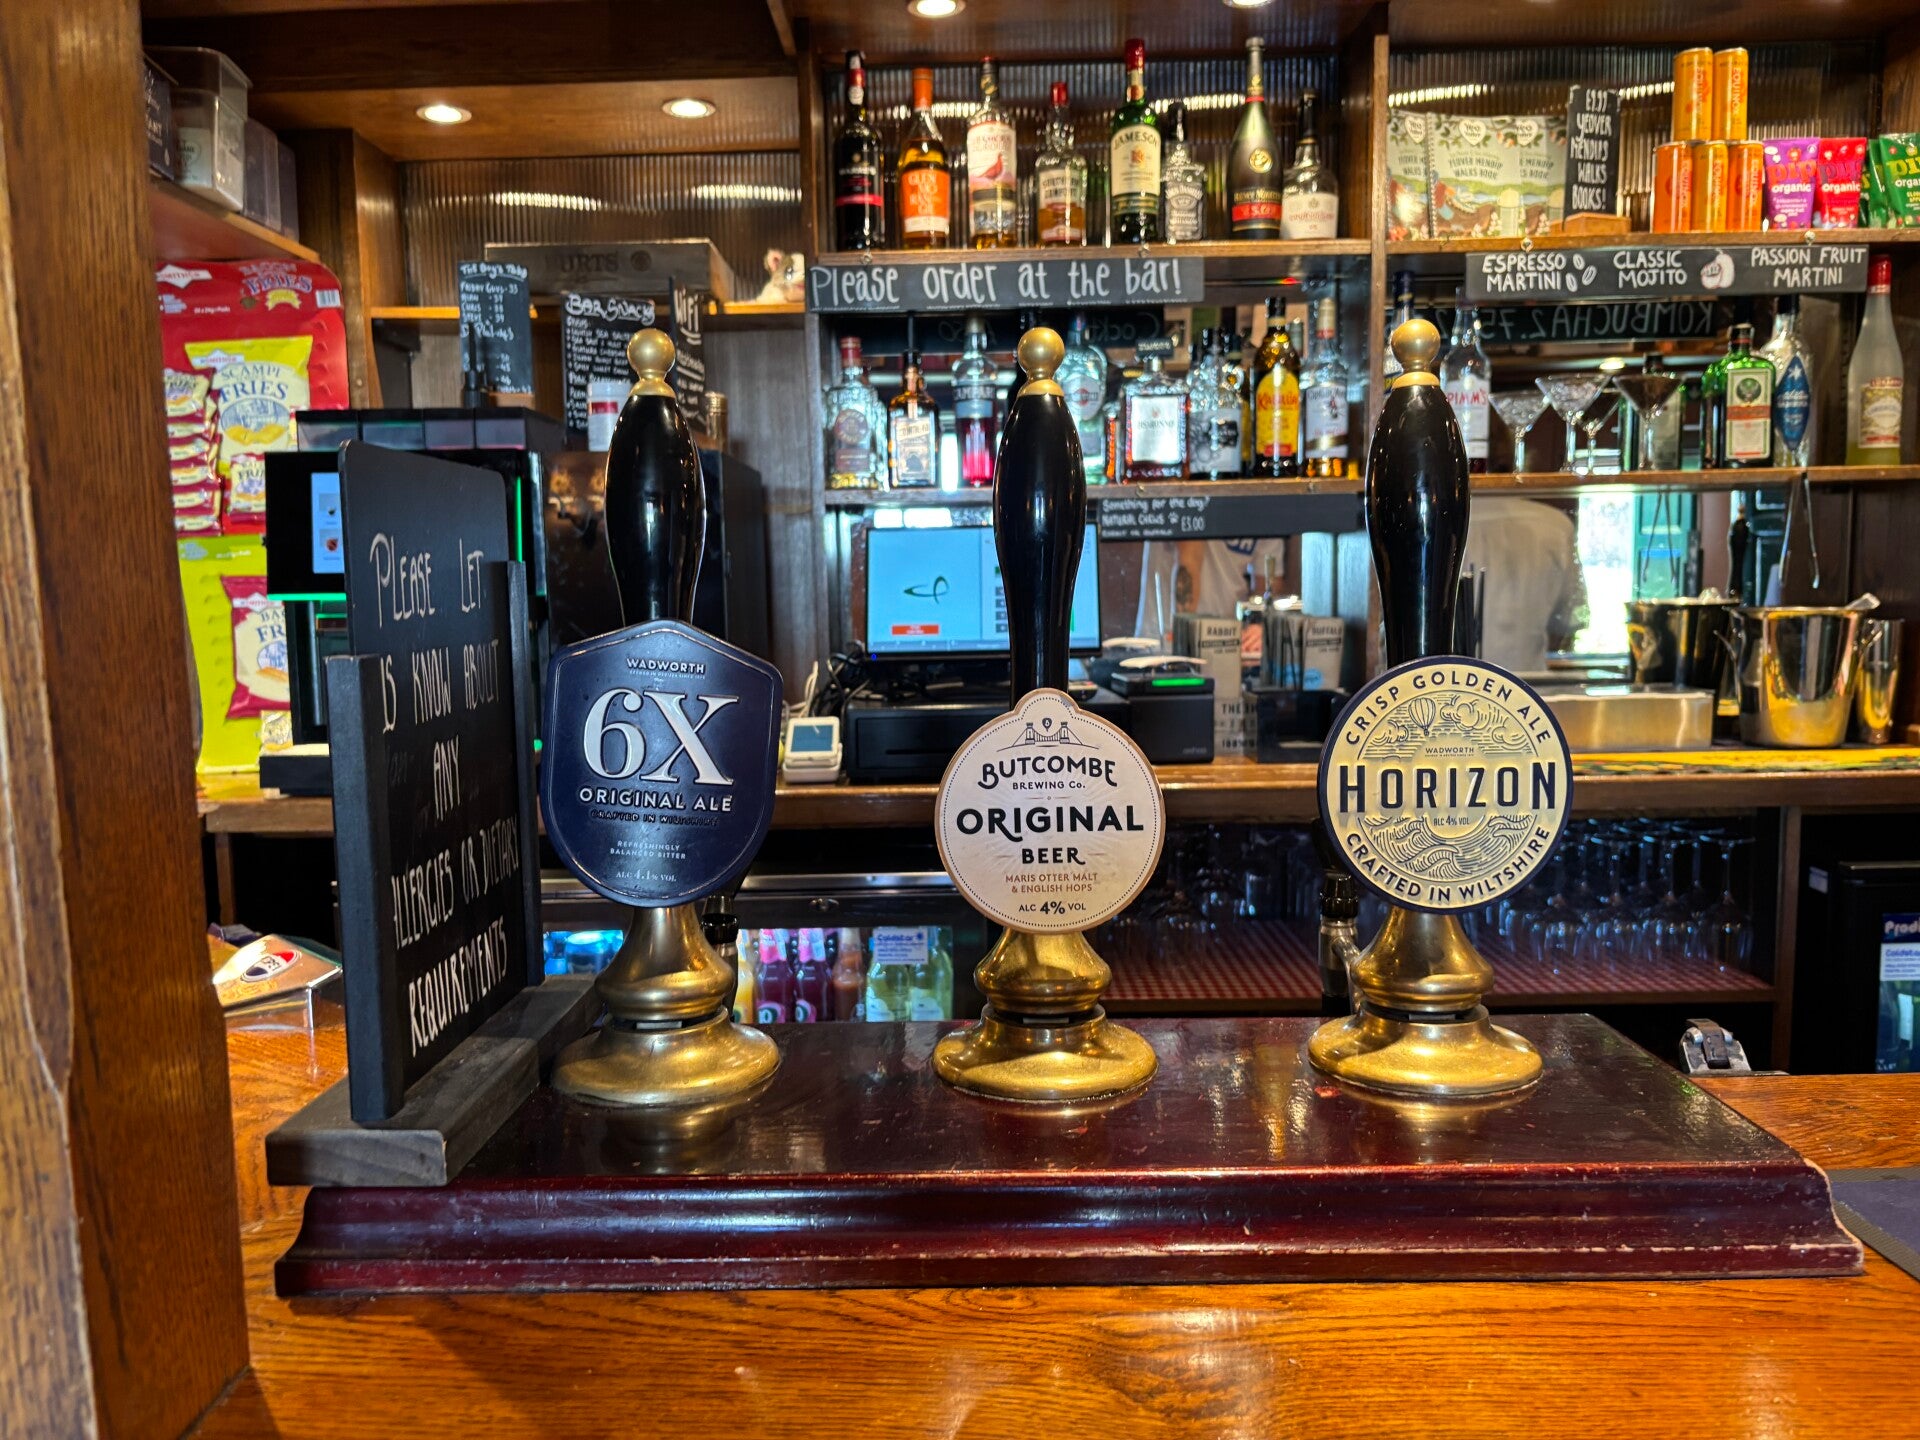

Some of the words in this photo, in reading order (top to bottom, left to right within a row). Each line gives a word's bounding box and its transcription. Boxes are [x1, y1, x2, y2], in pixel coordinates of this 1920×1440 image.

[1771, 182, 1812, 195] organic
[1482, 253, 1566, 274] ESPRESSO
[1613, 250, 1682, 269] CLASSIC
[1751, 248, 1811, 268] PASSION
[1820, 247, 1867, 266] FRUIT
[243, 274, 313, 296] FRIES
[810, 265, 899, 306] Please
[922, 262, 998, 304] order
[1018, 261, 1050, 300] at
[1067, 260, 1110, 299] the
[1125, 257, 1182, 296] bar!
[1486, 271, 1561, 293] MARTINI
[1617, 269, 1688, 289] MOJITO
[1773, 267, 1843, 288] MARTINI
[221, 365, 282, 380] SCAMPI
[219, 380, 289, 405] FRIES
[369, 532, 436, 629] PLEASE
[459, 538, 484, 614] LET
[1206, 626, 1238, 637] RABBIT
[627, 657, 706, 675] WADWORTH
[412, 647, 452, 726] KNOW
[463, 639, 499, 711] ABOUT
[1345, 686, 1399, 746] CRISP
[1413, 670, 1513, 702] GOLDEN
[1517, 704, 1551, 744] ALE
[583, 688, 740, 786] 6X
[1425, 746, 1475, 754] WADWORTH
[433, 734, 461, 822] ANY
[978, 755, 1118, 790] BUTCOMBE
[1013, 780, 1065, 790] BREWING
[1069, 780, 1086, 789] Co.
[1339, 762, 1556, 813] HORIZON
[579, 787, 686, 810] ORIGINAL
[693, 796, 733, 812] ALE
[591, 809, 640, 822] CRAFTED
[643, 813, 656, 823] IN
[660, 814, 719, 827] WILTSHIRE
[956, 805, 1144, 843] ORIGINAL
[1433, 817, 1445, 827] ALC
[1445, 815, 1458, 826] 4%
[1458, 816, 1470, 826] VOL
[610, 847, 655, 858] BALANCED
[658, 851, 686, 860] BITTER
[617, 840, 681, 852] REFRESHINGLY
[1021, 847, 1086, 866] BEER
[461, 836, 480, 905] OR
[480, 813, 520, 896] DIETARY
[1346, 833, 1421, 897] CRAFTED
[1429, 886, 1451, 902] IN
[1459, 826, 1550, 901] WILTSHIRE
[616, 871, 633, 880] ALC
[1005, 874, 1036, 883] MARIS
[1038, 873, 1070, 883] OTTER
[1072, 872, 1099, 882] MALT
[1011, 885, 1019, 894] &
[1021, 884, 1063, 893] ENGLISH
[1066, 883, 1093, 893] HOPS
[1018, 903, 1037, 913] ALC
[1039, 901, 1066, 915] 4%
[1069, 902, 1087, 911] VOL
[408, 915, 508, 1059] REQUIREMENTS
